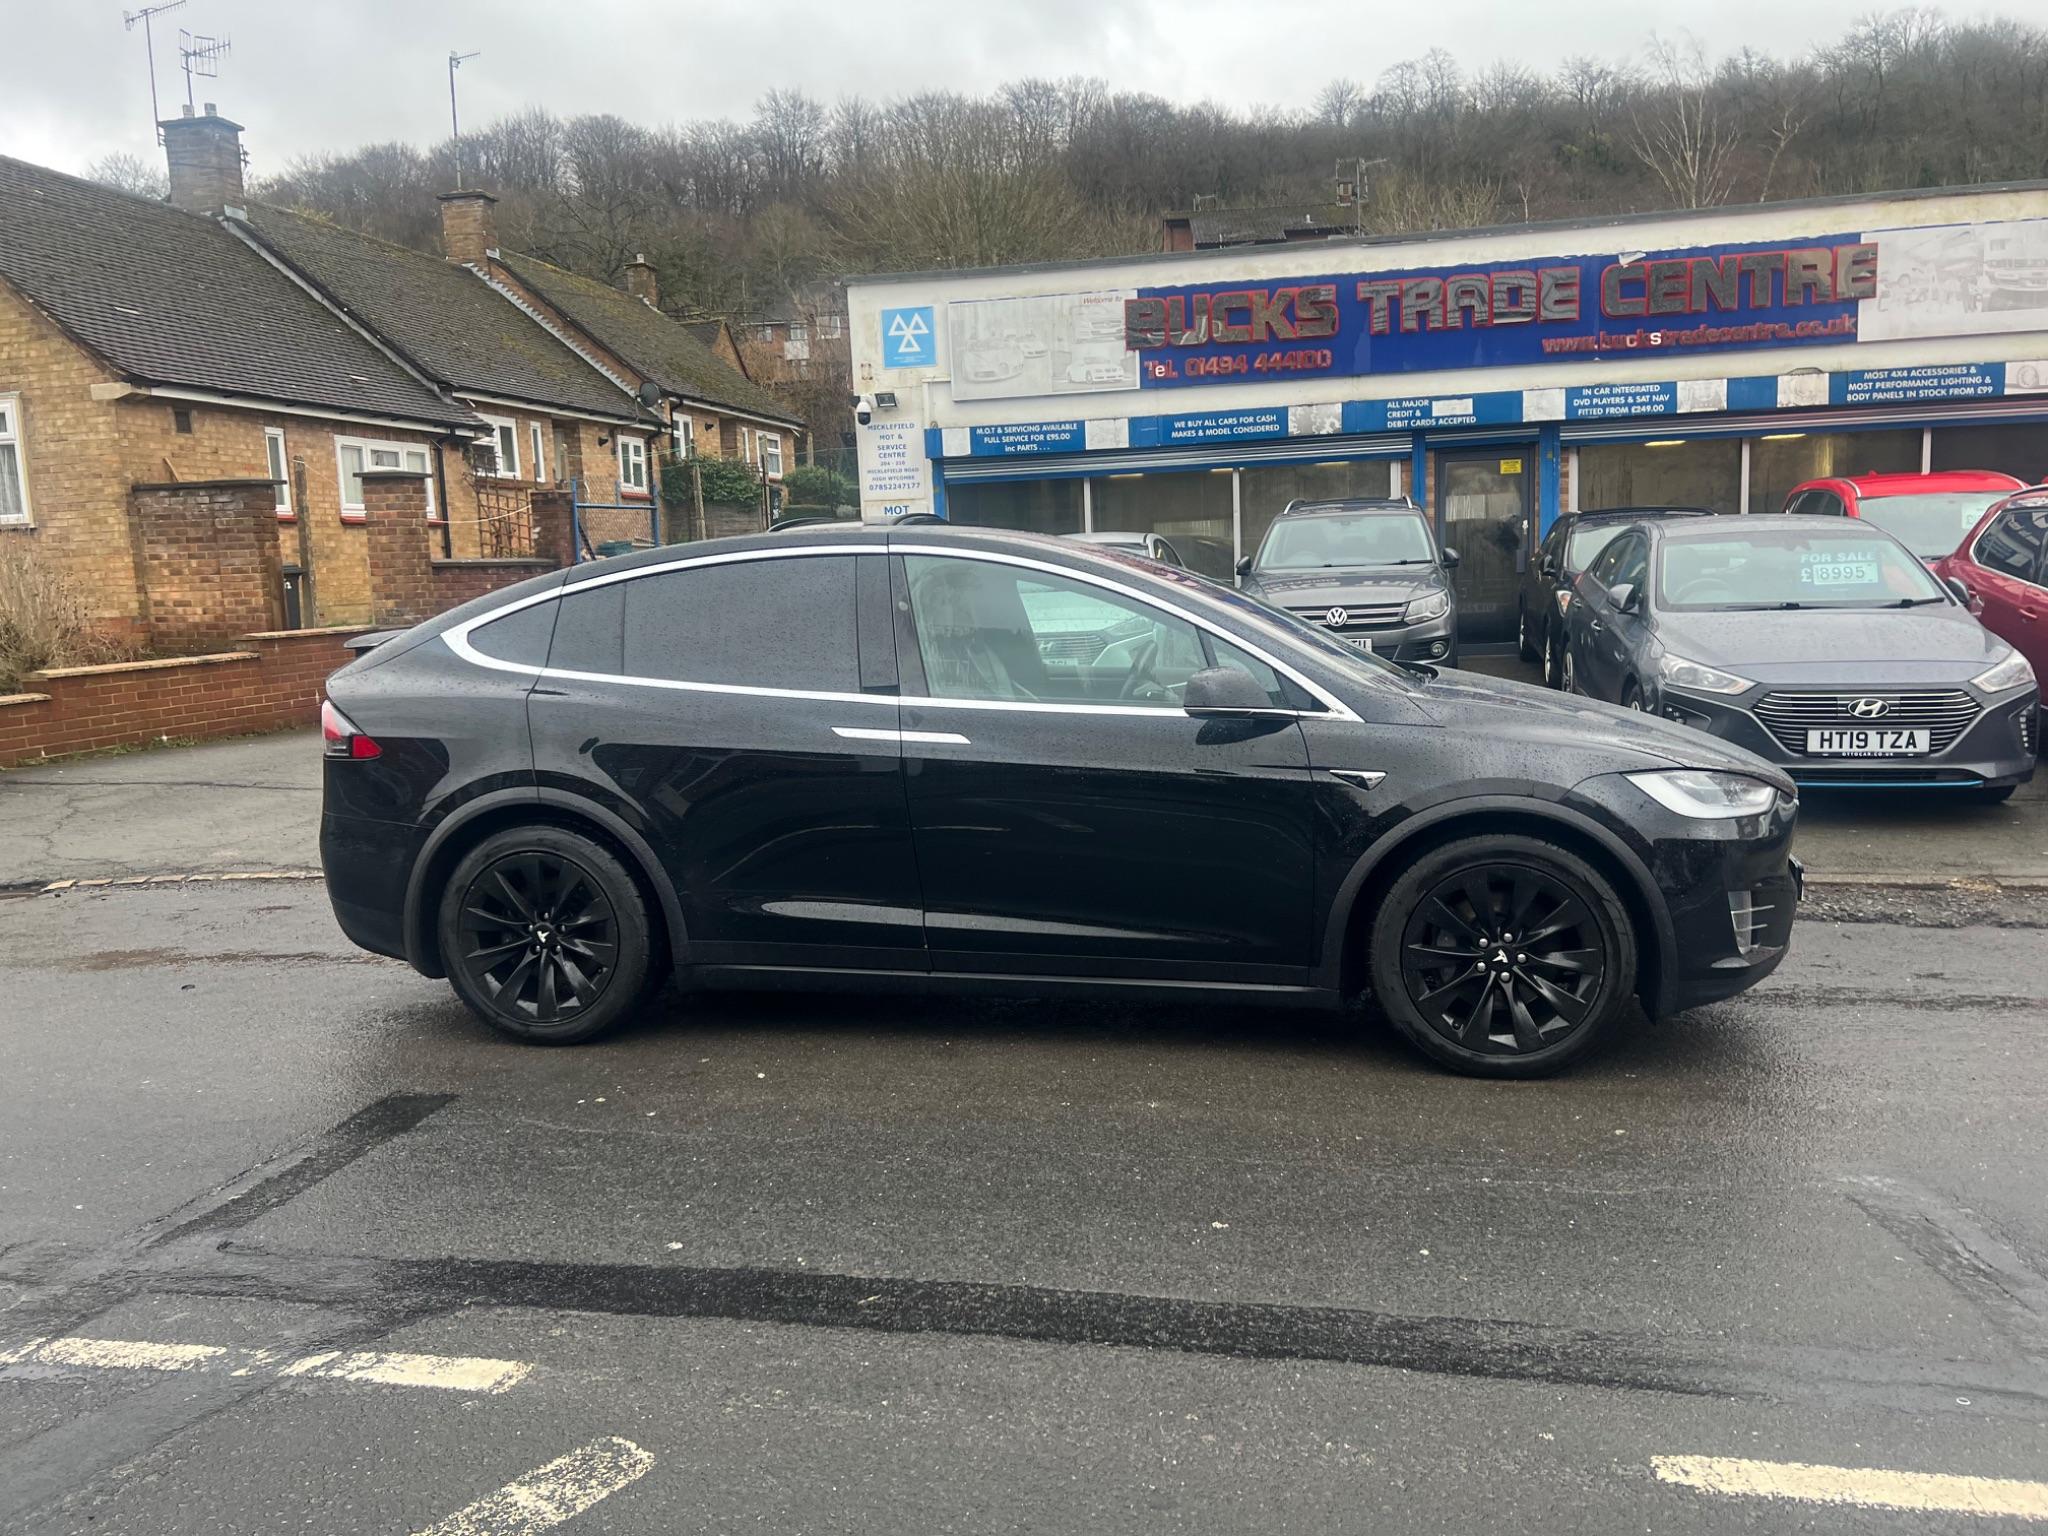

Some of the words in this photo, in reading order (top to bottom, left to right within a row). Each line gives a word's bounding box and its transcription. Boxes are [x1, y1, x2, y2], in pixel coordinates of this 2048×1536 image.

[1125, 284, 1339, 351] BUCKS
[1357, 265, 1580, 335] TRADE
[1601, 243, 1878, 318] CENTRE
[1863, 371, 1888, 380] MOST
[1890, 370, 1908, 378] 4X4
[1910, 366, 1967, 377] ACCESSORIES
[1969, 366, 1977, 374] &
[1848, 382, 1873, 391] MOST
[1875, 378, 1938, 389] PERFORMANCE
[1941, 376, 1982, 386] LIGHTING
[1984, 375, 1992, 383] &
[1582, 388, 1592, 396] IN
[1594, 387, 1610, 395] CAR
[1612, 384, 1660, 394] INTEGRATED
[1846, 393, 1870, 402] BODY
[1872, 390, 1904, 400] PANELS
[1906, 389, 1917, 397] IN
[1918, 388, 1947, 397] STOCK
[1949, 386, 1975, 395] FROM
[1977, 385, 1993, 394] £99
[1387, 401, 1400, 409] ALL
[1401, 399, 1429, 408] MAJOR
[1592, 396, 1625, 405] PLAYERS
[1636, 394, 1651, 403] SAT
[1652, 394, 1670, 402] NAV
[1387, 410, 1413, 418] CREDIT
[1414, 409, 1422, 417] &
[1578, 408, 1603, 416] FITTED
[1605, 406, 1629, 415] FROM
[1174, 421, 1186, 429] WE
[1187, 420, 1203, 428] BUY
[1204, 419, 1216, 427] ALL
[1218, 417, 1237, 426] CARS
[1240, 416, 1253, 424] FOR
[1256, 415, 1276, 423] CASH
[1387, 420, 1408, 428] DEBIT
[1410, 418, 1436, 427] CARDS
[1438, 415, 1477, 425] ACCEPTED
[1004, 424, 1040, 434] SERVICING
[1042, 423, 1078, 431] AVAILABLE
[1171, 430, 1196, 438] MAKES
[1205, 427, 1232, 436] MODEL
[1233, 424, 1280, 434] CONSIDERED
[984, 436, 1000, 444] FULL
[1002, 435, 1029, 443] SERVICE
[884, 505, 910, 515] MOT
[1800, 553, 1832, 563] FOR
[1837, 551, 1875, 561] SALE
[1820, 731, 1869, 749] HT19
[1876, 731, 1917, 749] TZA
